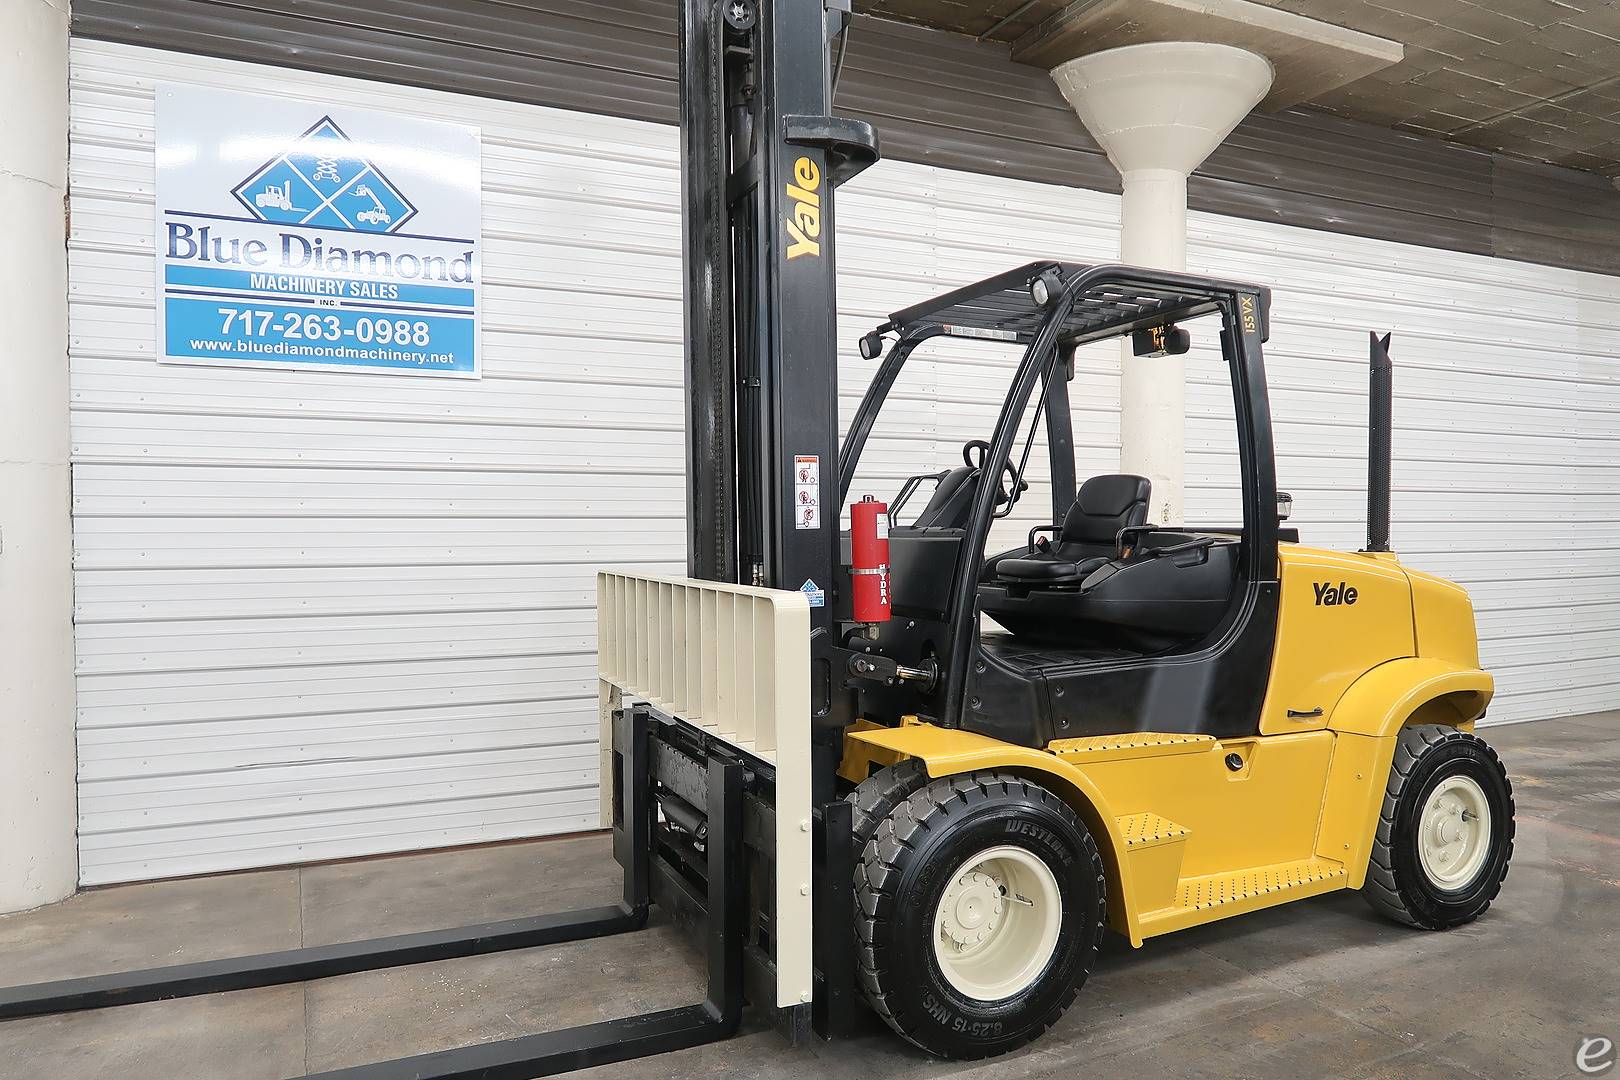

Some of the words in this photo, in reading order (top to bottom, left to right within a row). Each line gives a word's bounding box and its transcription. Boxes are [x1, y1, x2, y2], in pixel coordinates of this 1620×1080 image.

[786, 156, 820, 260] Yale
[165, 222, 268, 266] Blue
[279, 232, 474, 284] Diamond
[250, 273, 345, 297] MACHINERY
[350, 281, 399, 299] SALES
[319, 299, 338, 307] INC.
[217, 308, 431, 346] 717-263-0988
[190, 338, 455, 365] www.bluediamondmachinery.net
[1312, 581, 1359, 606] Yale
